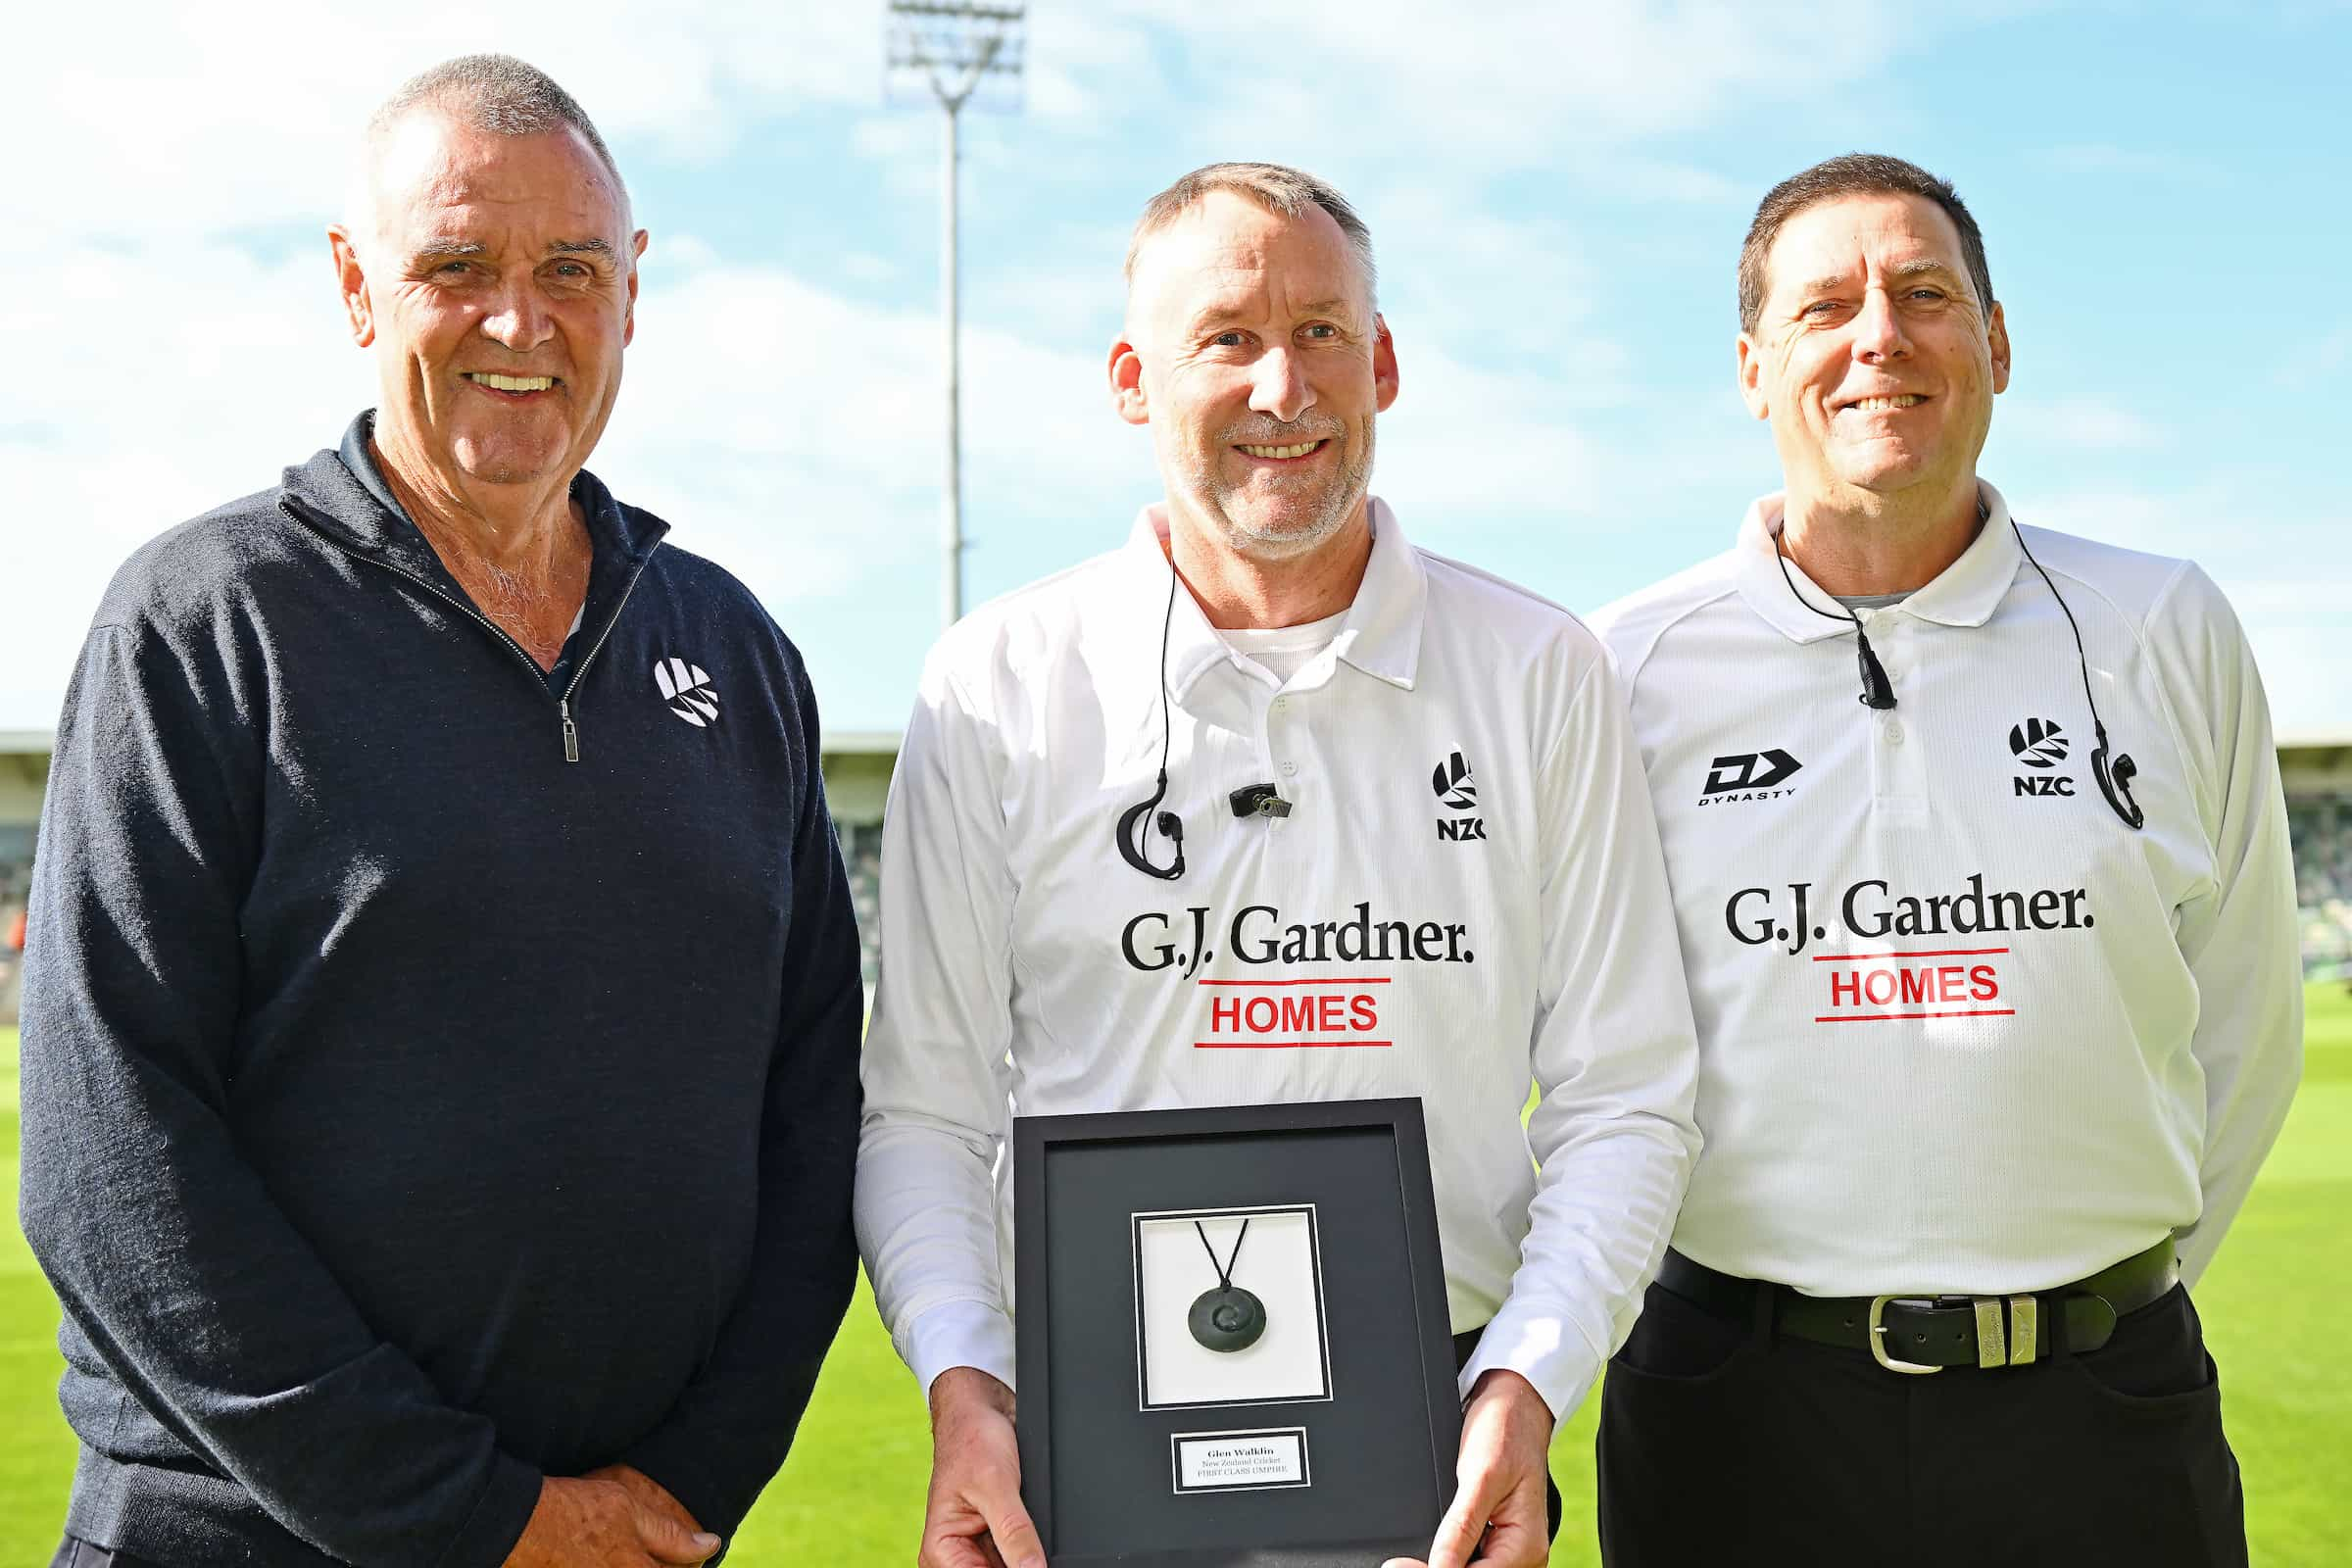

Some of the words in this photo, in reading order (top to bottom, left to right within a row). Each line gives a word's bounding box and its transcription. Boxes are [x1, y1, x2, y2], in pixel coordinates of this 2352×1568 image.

[2014, 776, 2076, 797] NZC
[1698, 789, 1795, 807] DYNASTY
[1725, 883, 1826, 956] G.J.
[1842, 873, 2094, 938] Gardner.
[1121, 906, 1213, 980] G.J.
[1230, 902, 1475, 964] Gardner.
[1831, 965, 1998, 1006] HOMES
[1211, 995, 1378, 1033] HOMES
[1207, 1449, 1231, 1458] Glen
[1221, 1458, 1251, 1467] Zealand
[1253, 1456, 1280, 1465] Cricket
[1198, 1469, 1222, 1478] FIRST
[1224, 1467, 1250, 1476] CLASS
